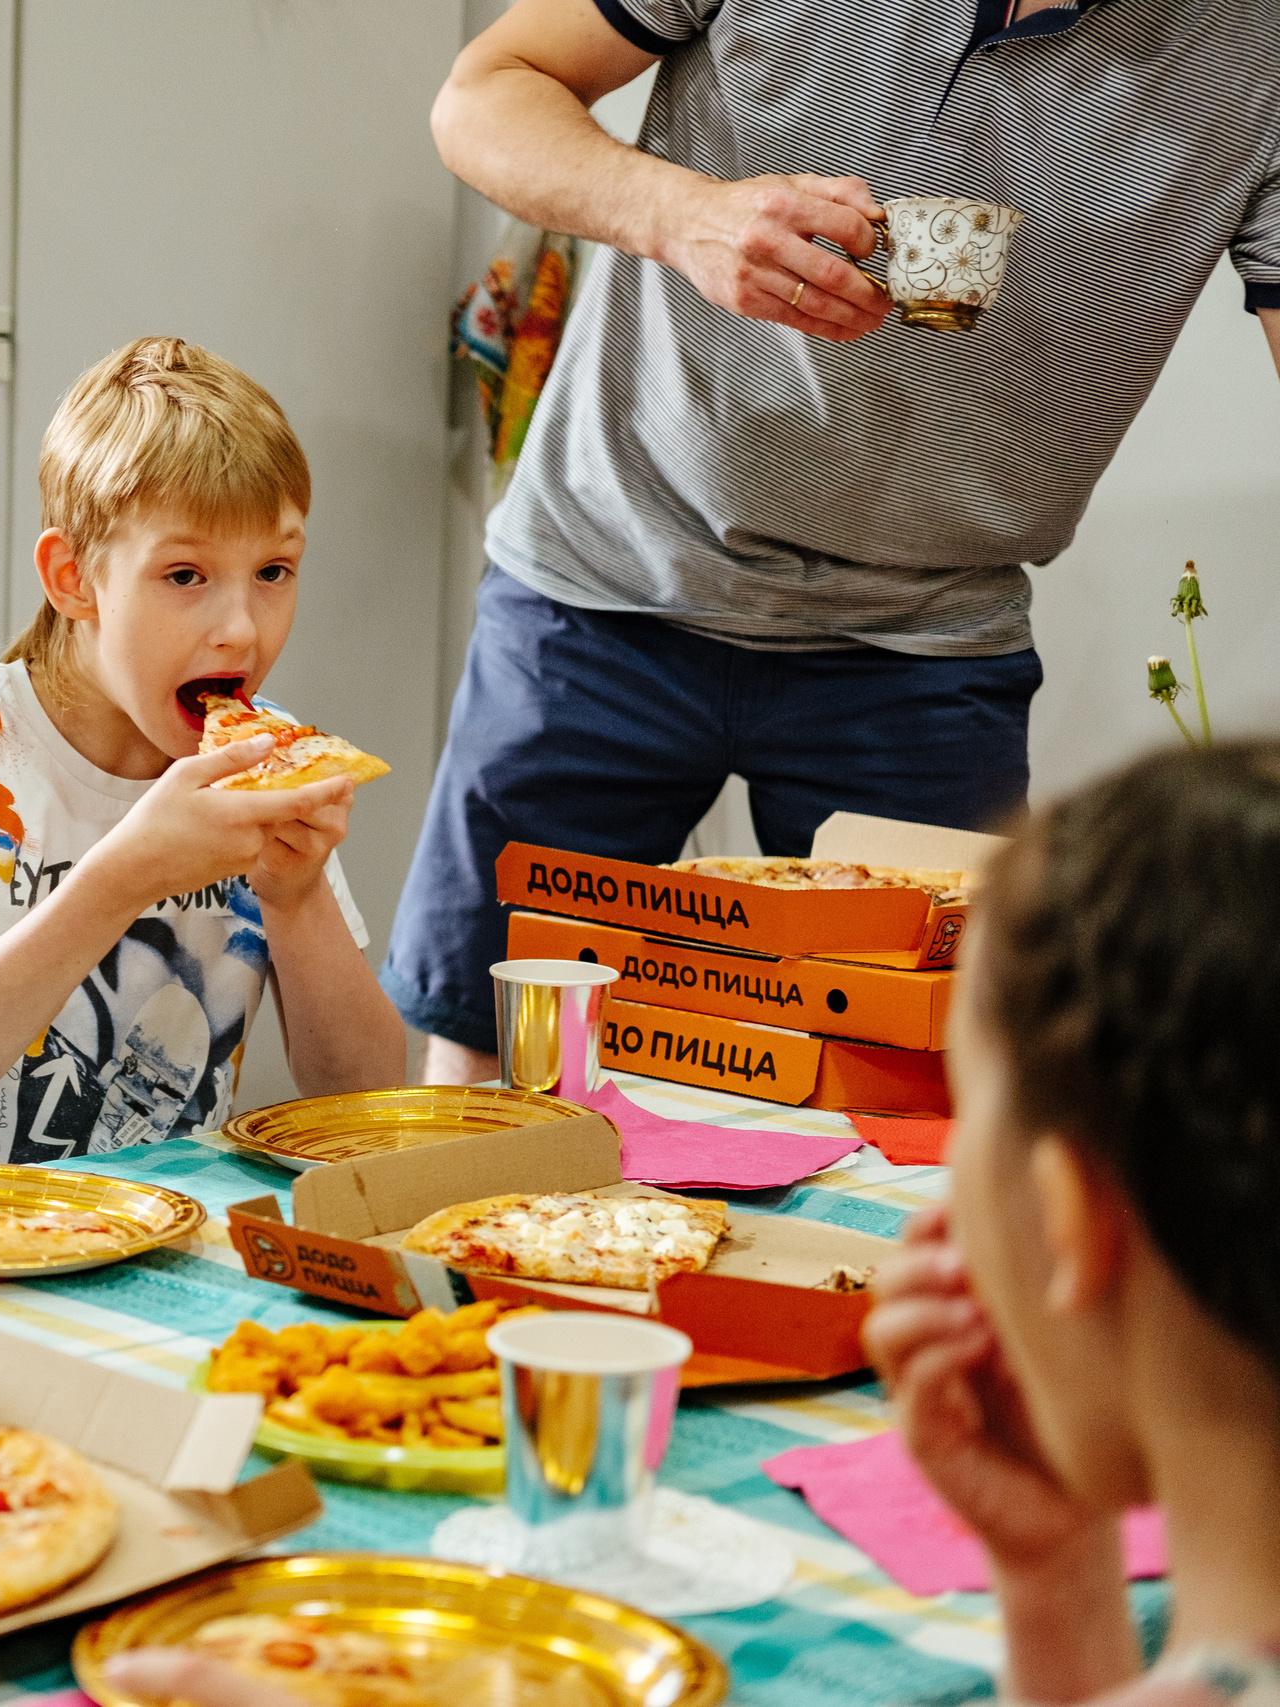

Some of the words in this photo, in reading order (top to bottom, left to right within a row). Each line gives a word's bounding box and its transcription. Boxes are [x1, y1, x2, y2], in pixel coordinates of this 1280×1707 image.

[527, 863, 618, 905] ДОДО
[626, 880, 749, 930] ПИЦЦА
[621, 956, 697, 989] ДОДО
[704, 969, 803, 1007] ПИЦЦА
[604, 1022, 643, 1056] ДО
[650, 1030, 777, 1082] ПИЦЦА
[298, 1245, 356, 1271] ДОДО
[302, 1267, 381, 1298] ПИЦЦА
